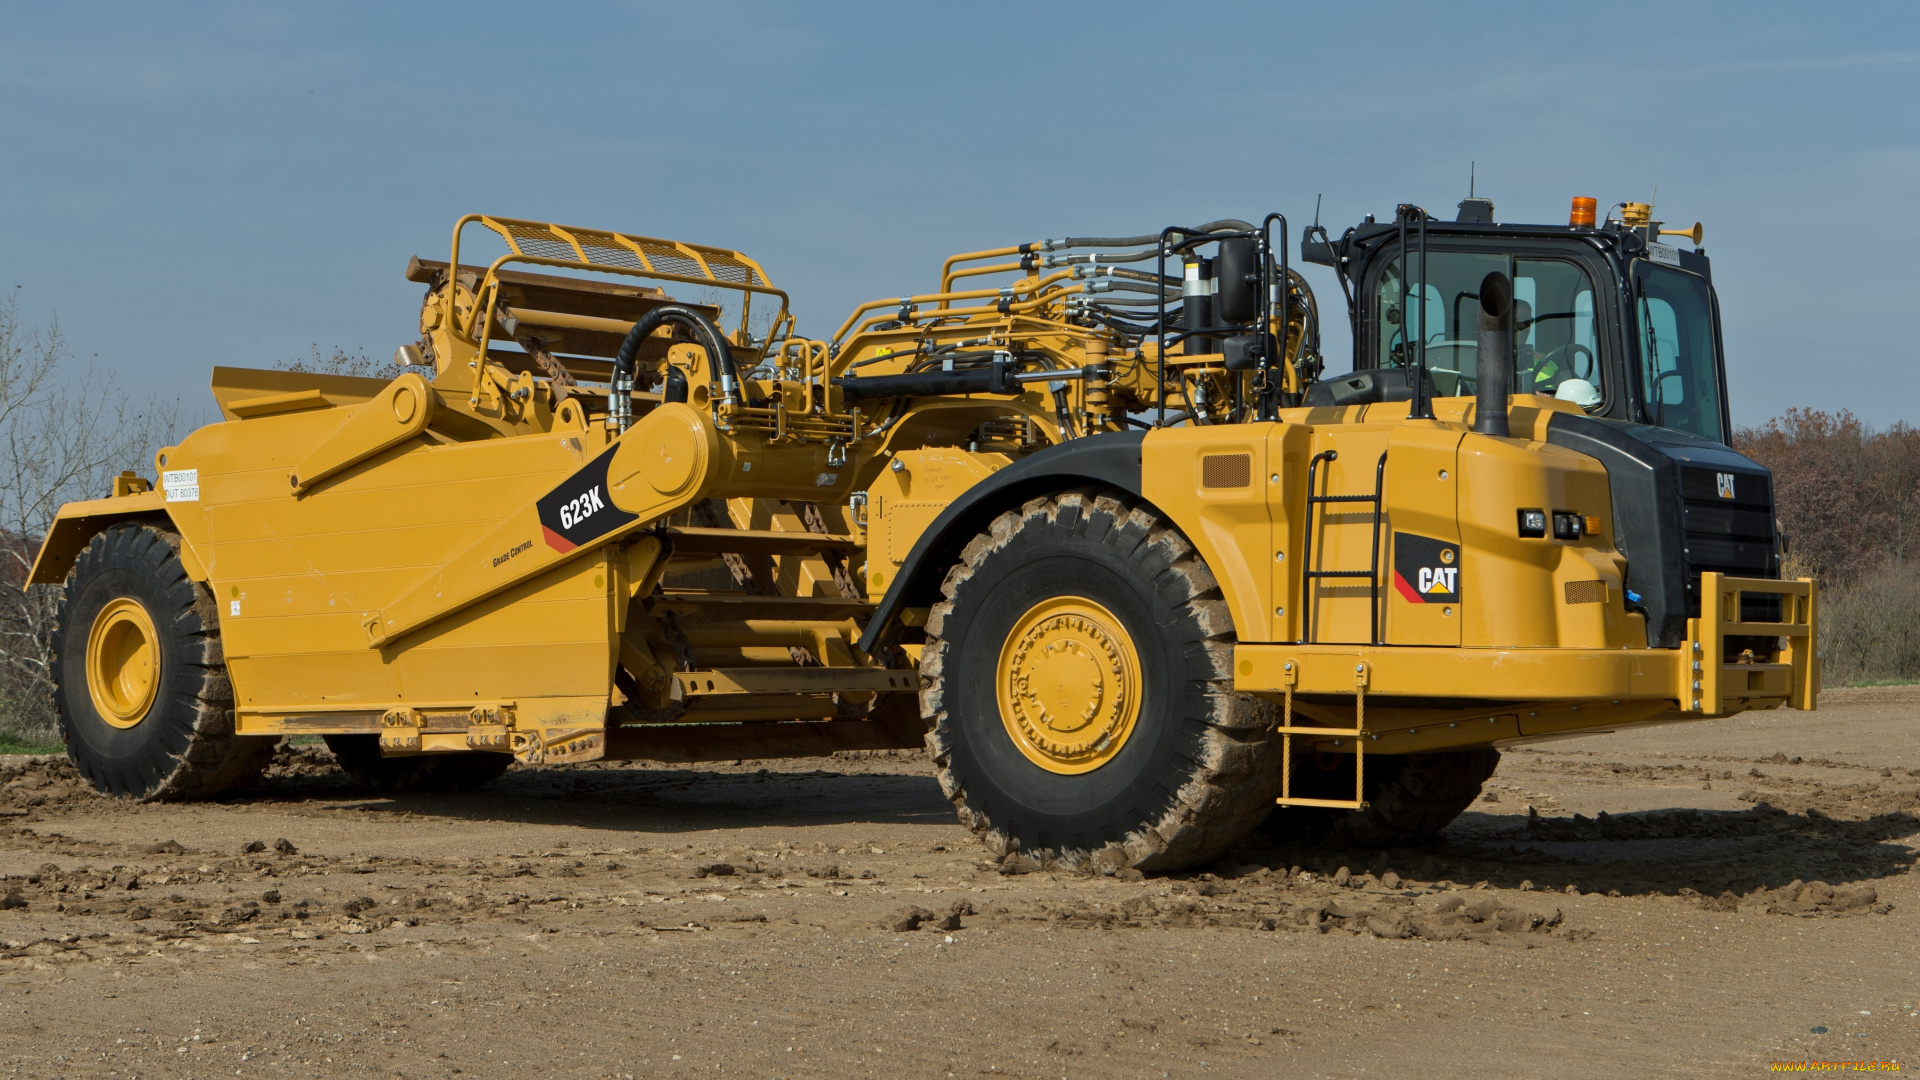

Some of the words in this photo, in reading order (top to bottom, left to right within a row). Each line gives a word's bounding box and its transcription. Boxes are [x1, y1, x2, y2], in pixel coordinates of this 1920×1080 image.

[164, 472, 197, 483] WTB00101
[1717, 472, 1735, 499] CAT
[180, 487, 199, 498] 80376
[560, 485, 605, 530] 623K
[492, 552, 510, 568] GRADE
[510, 540, 533, 558] CONTROL
[1418, 566, 1458, 594] CAT
